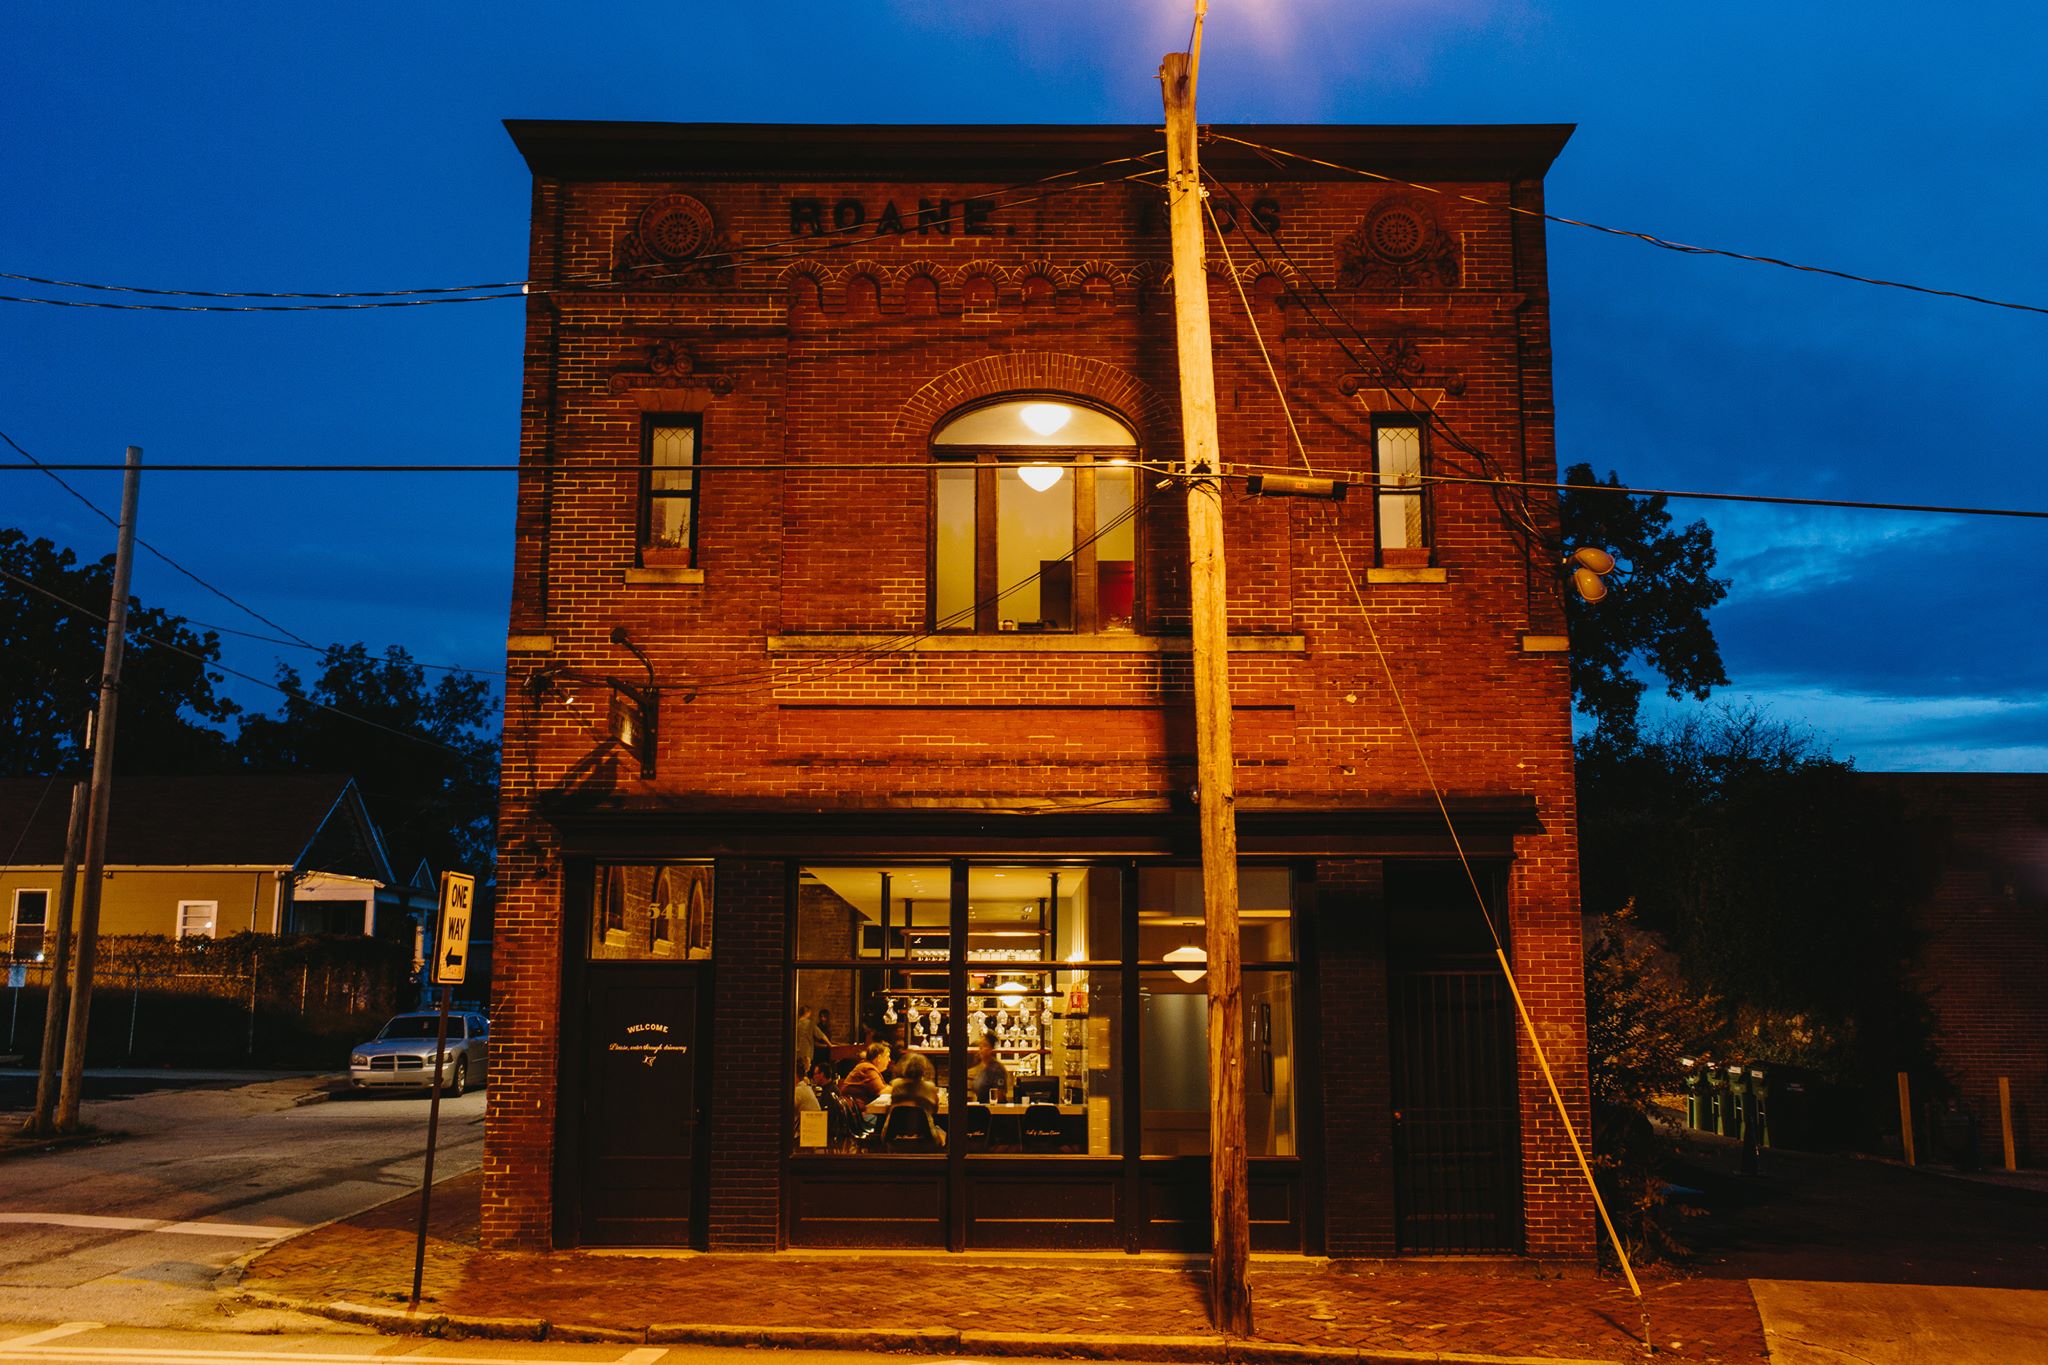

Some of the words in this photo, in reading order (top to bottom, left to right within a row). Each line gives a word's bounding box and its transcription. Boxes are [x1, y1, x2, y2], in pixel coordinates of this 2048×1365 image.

[451, 883, 469, 909] ONE
[646, 903, 687, 920] 541
[448, 917, 466, 941] WAY
[626, 1023, 669, 1034] WELCOME
